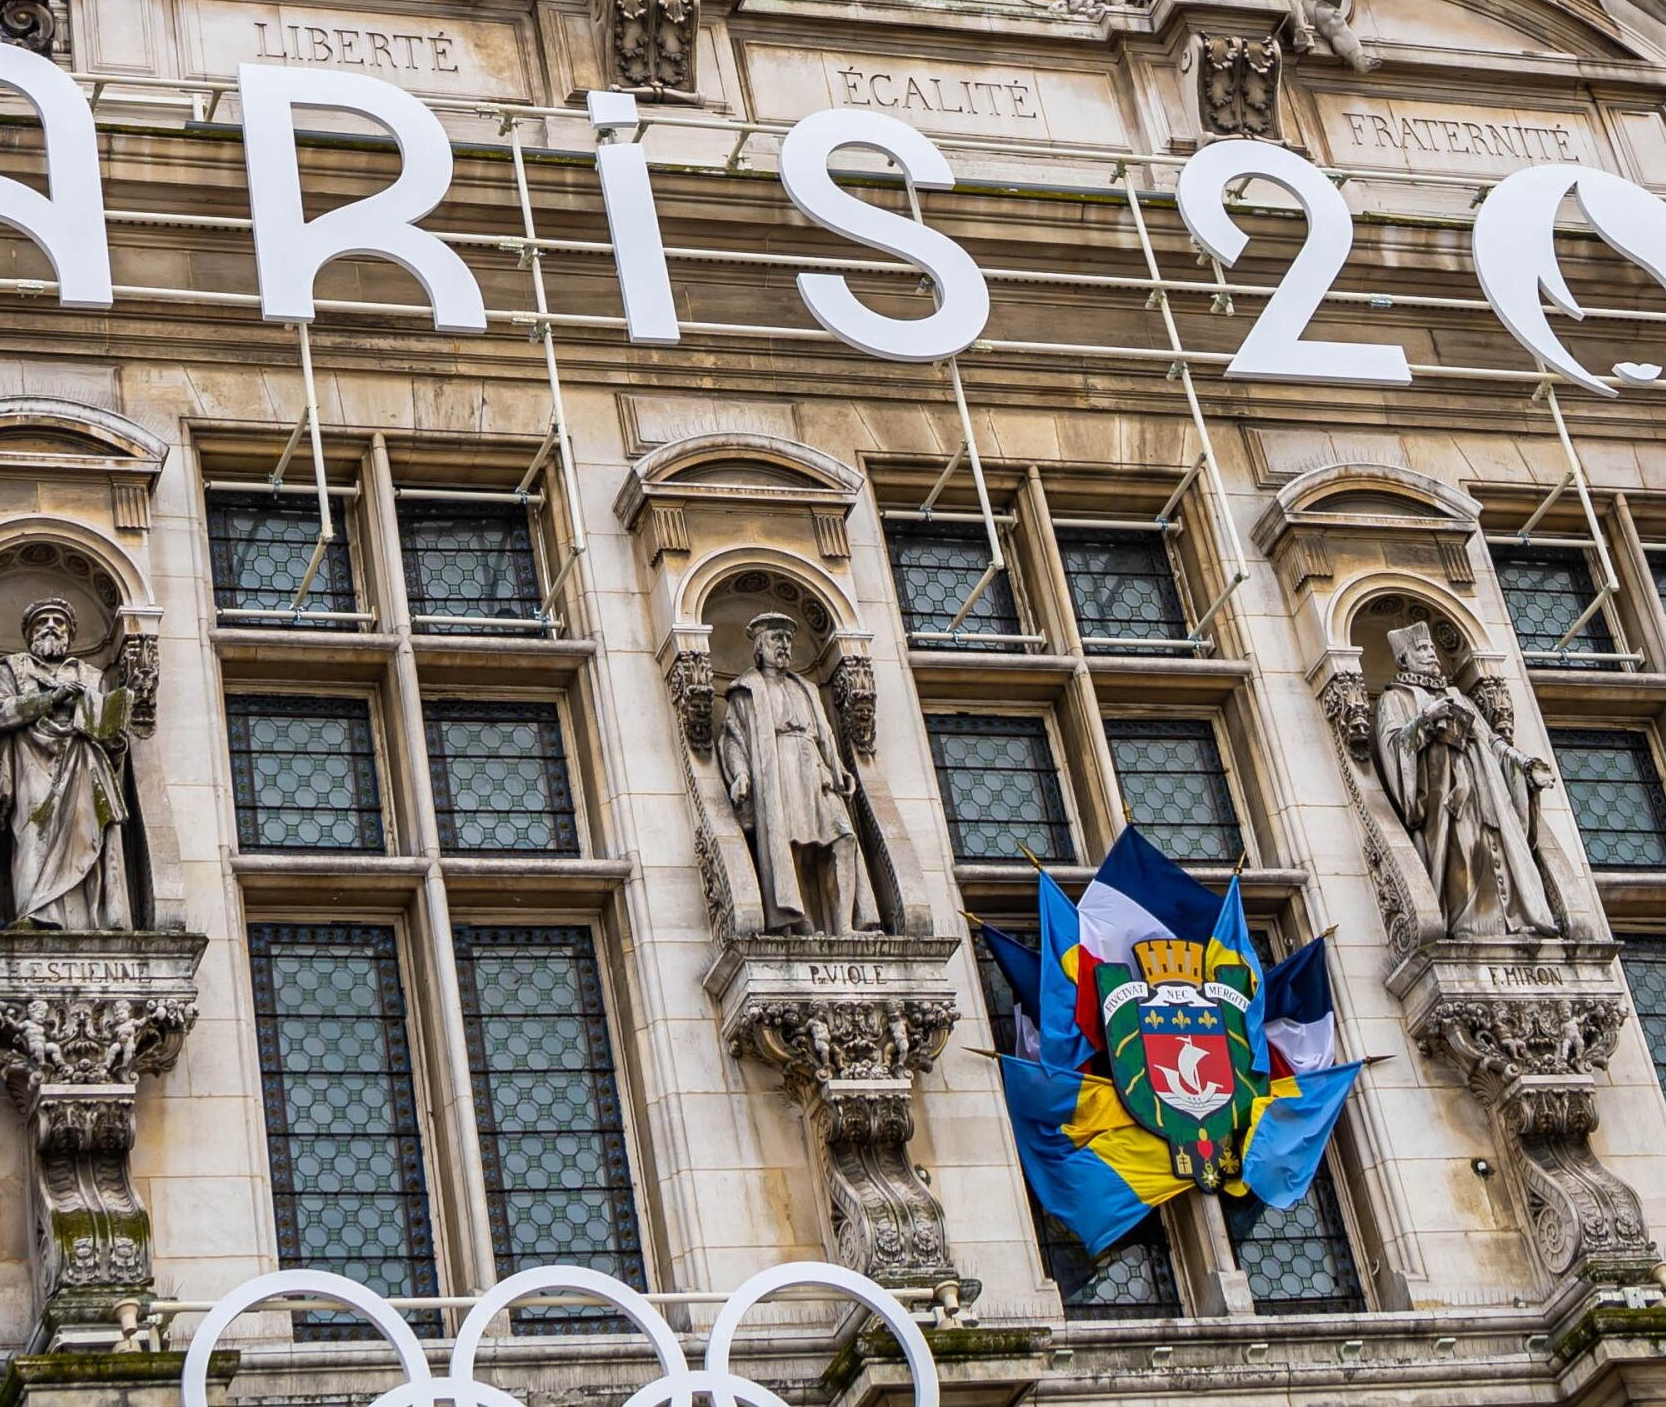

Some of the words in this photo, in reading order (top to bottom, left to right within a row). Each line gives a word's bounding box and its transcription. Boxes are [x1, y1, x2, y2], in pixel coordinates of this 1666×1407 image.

[254, 22, 459, 73] LIBERTÉ
[1342, 112, 1579, 162] FRATERNITÉ
[1167, 990, 1189, 1000] NEC
